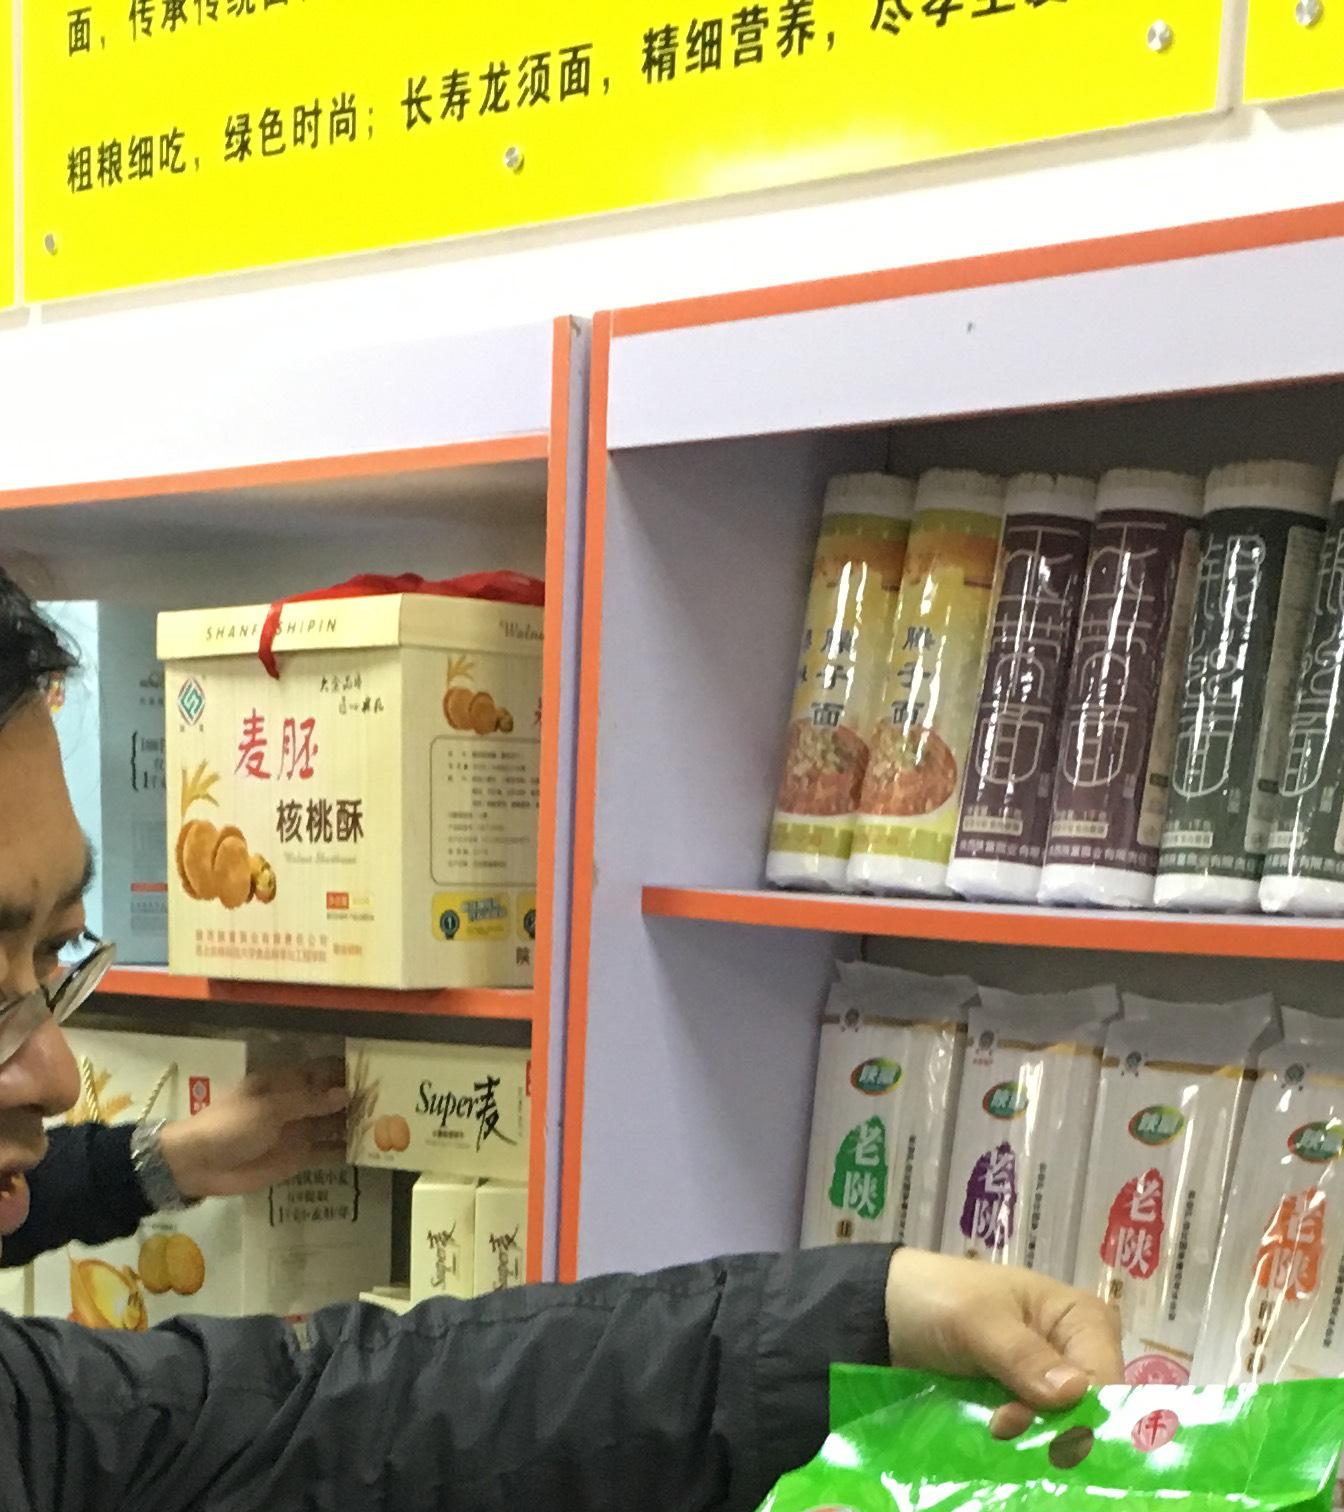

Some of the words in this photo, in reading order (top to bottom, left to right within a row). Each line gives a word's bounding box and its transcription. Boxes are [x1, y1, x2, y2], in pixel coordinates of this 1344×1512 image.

[206, 622, 259, 641] SHANF
[275, 618, 337, 636] SHIPIN
[275, 798, 364, 844] 核桃酥
[842, 1128, 882, 1213] 老陕
[1118, 1175, 1162, 1276] 老陕
